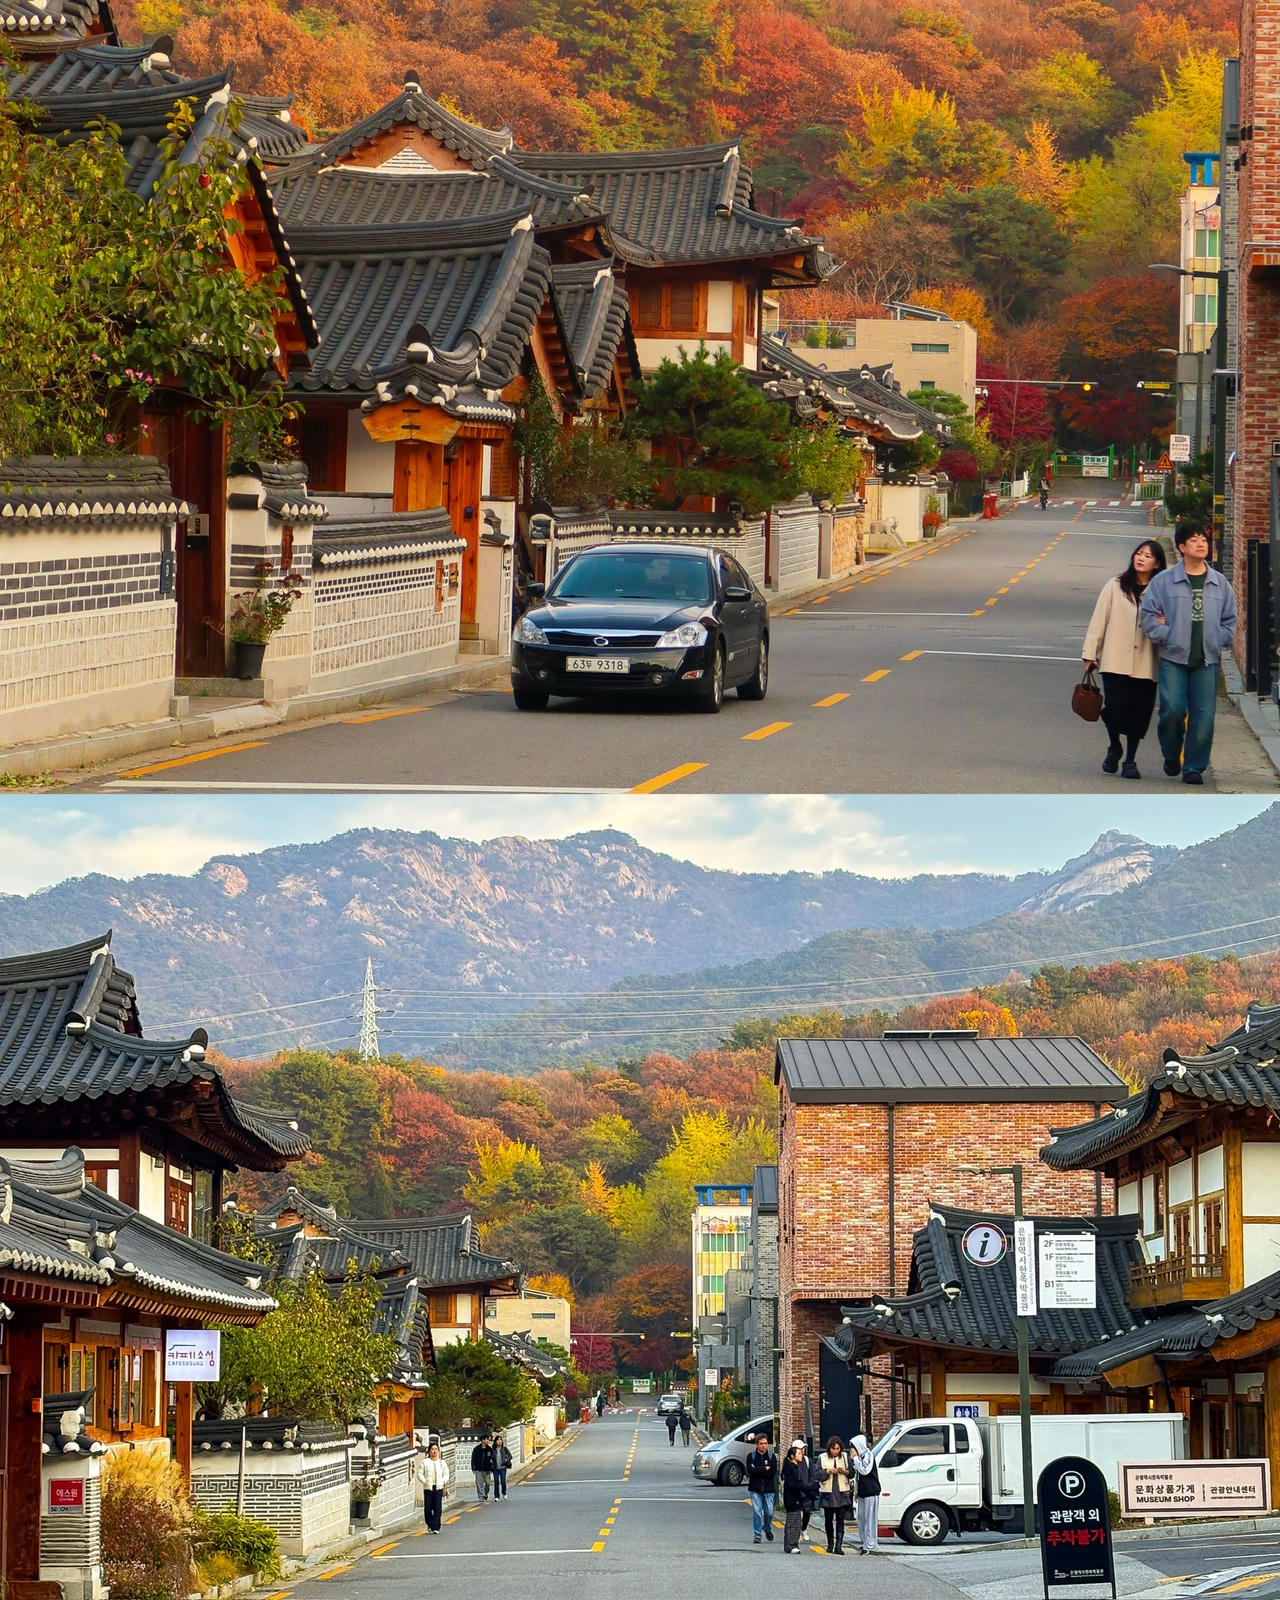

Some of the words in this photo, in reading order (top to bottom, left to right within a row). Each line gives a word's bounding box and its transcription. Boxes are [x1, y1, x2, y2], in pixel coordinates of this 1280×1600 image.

[572, 659, 592, 670] 63두
[597, 660, 624, 671] 9318
[1043, 1239, 1054, 1248] 2F
[1044, 1253, 1054, 1261] 1F
[1044, 1280, 1054, 1288] B1
[168, 1350, 215, 1367] 카페소성
[1135, 1484, 1195, 1495] 문화상품가게
[1210, 1485, 1256, 1494] 관광안내센터
[1136, 1495, 1172, 1503] MUSEUM
[1173, 1495, 1195, 1503] SHOP
[1049, 1509, 1085, 1524] 관람객
[1088, 1508, 1100, 1522] 외
[1046, 1527, 1106, 1547] 주차불가
